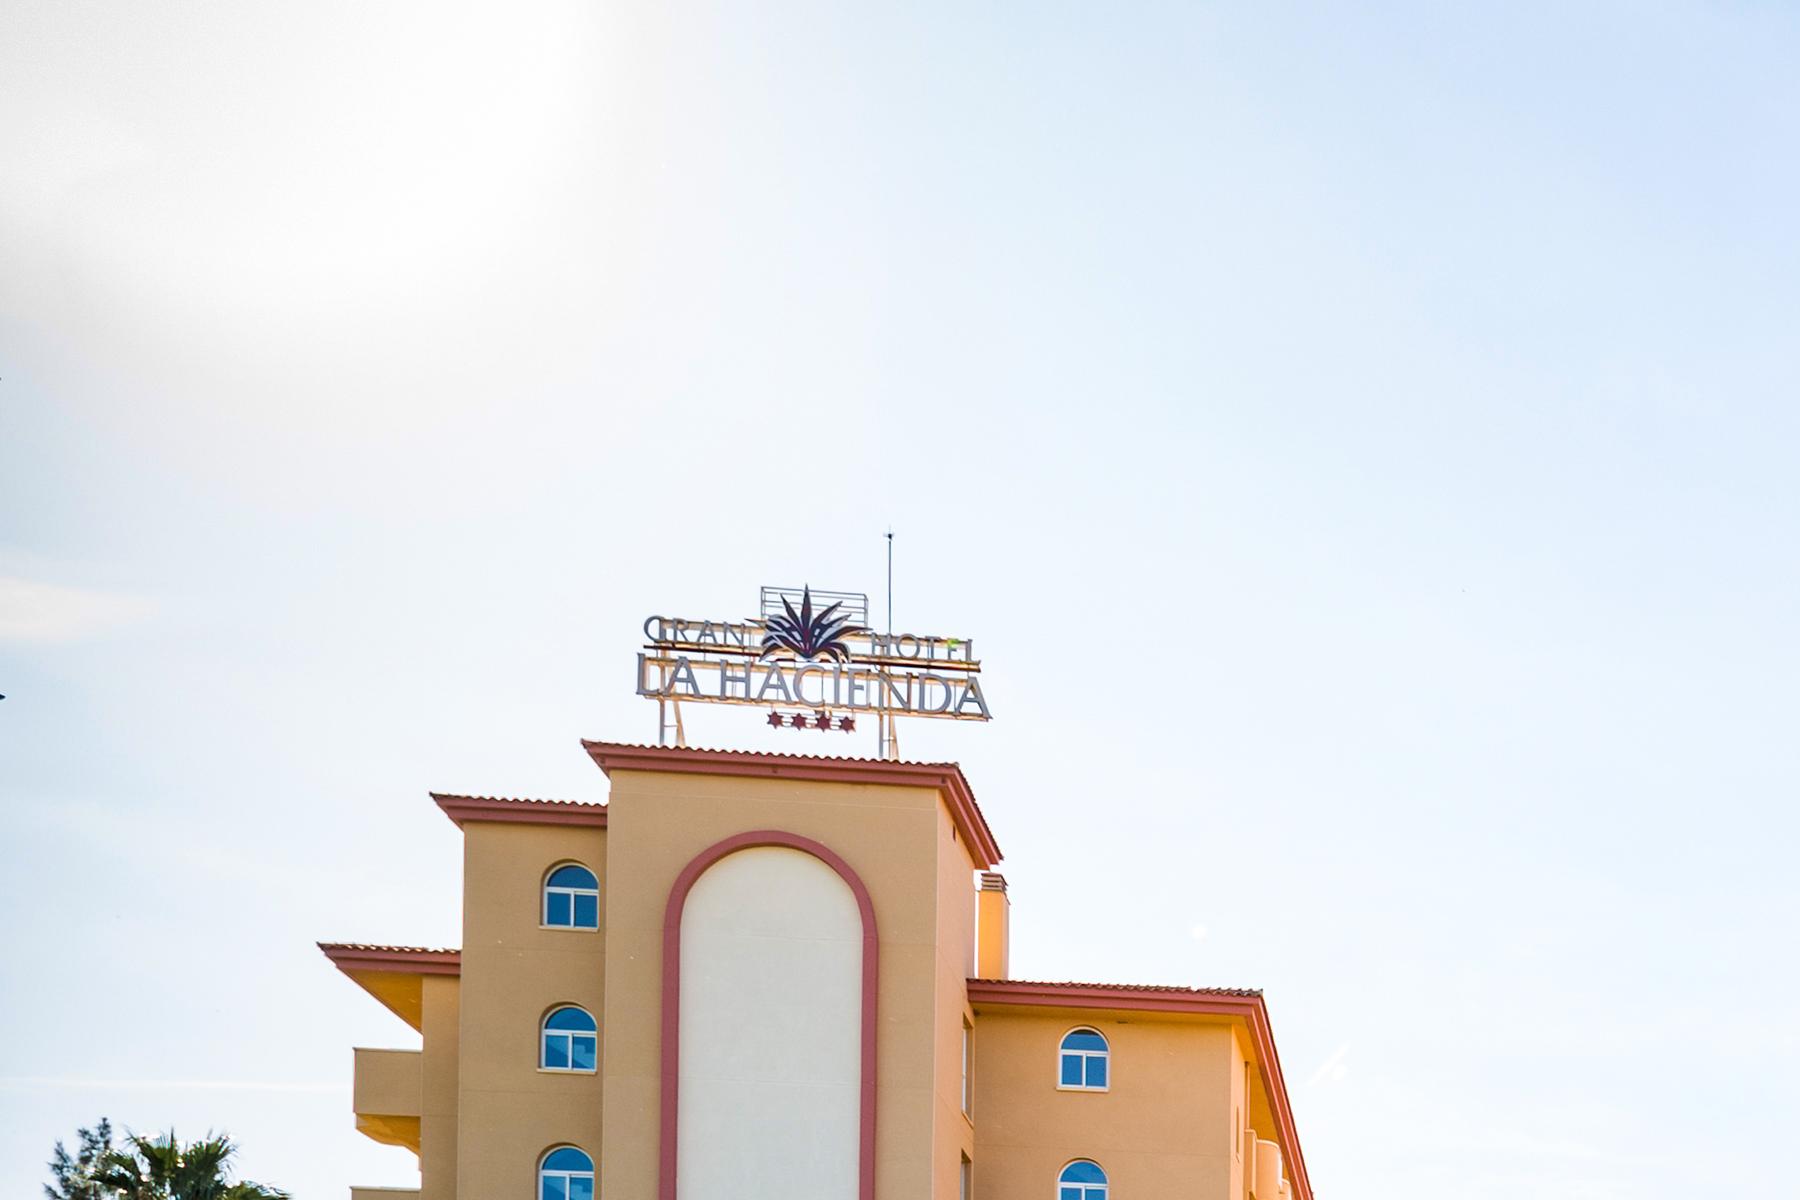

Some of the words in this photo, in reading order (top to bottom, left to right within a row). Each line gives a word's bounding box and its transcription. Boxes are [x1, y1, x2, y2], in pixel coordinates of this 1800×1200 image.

[643, 615, 745, 646] GRAN
[871, 632, 982, 665] HOTEL
[636, 653, 703, 698] LA
[719, 659, 993, 720] HACIENDA
